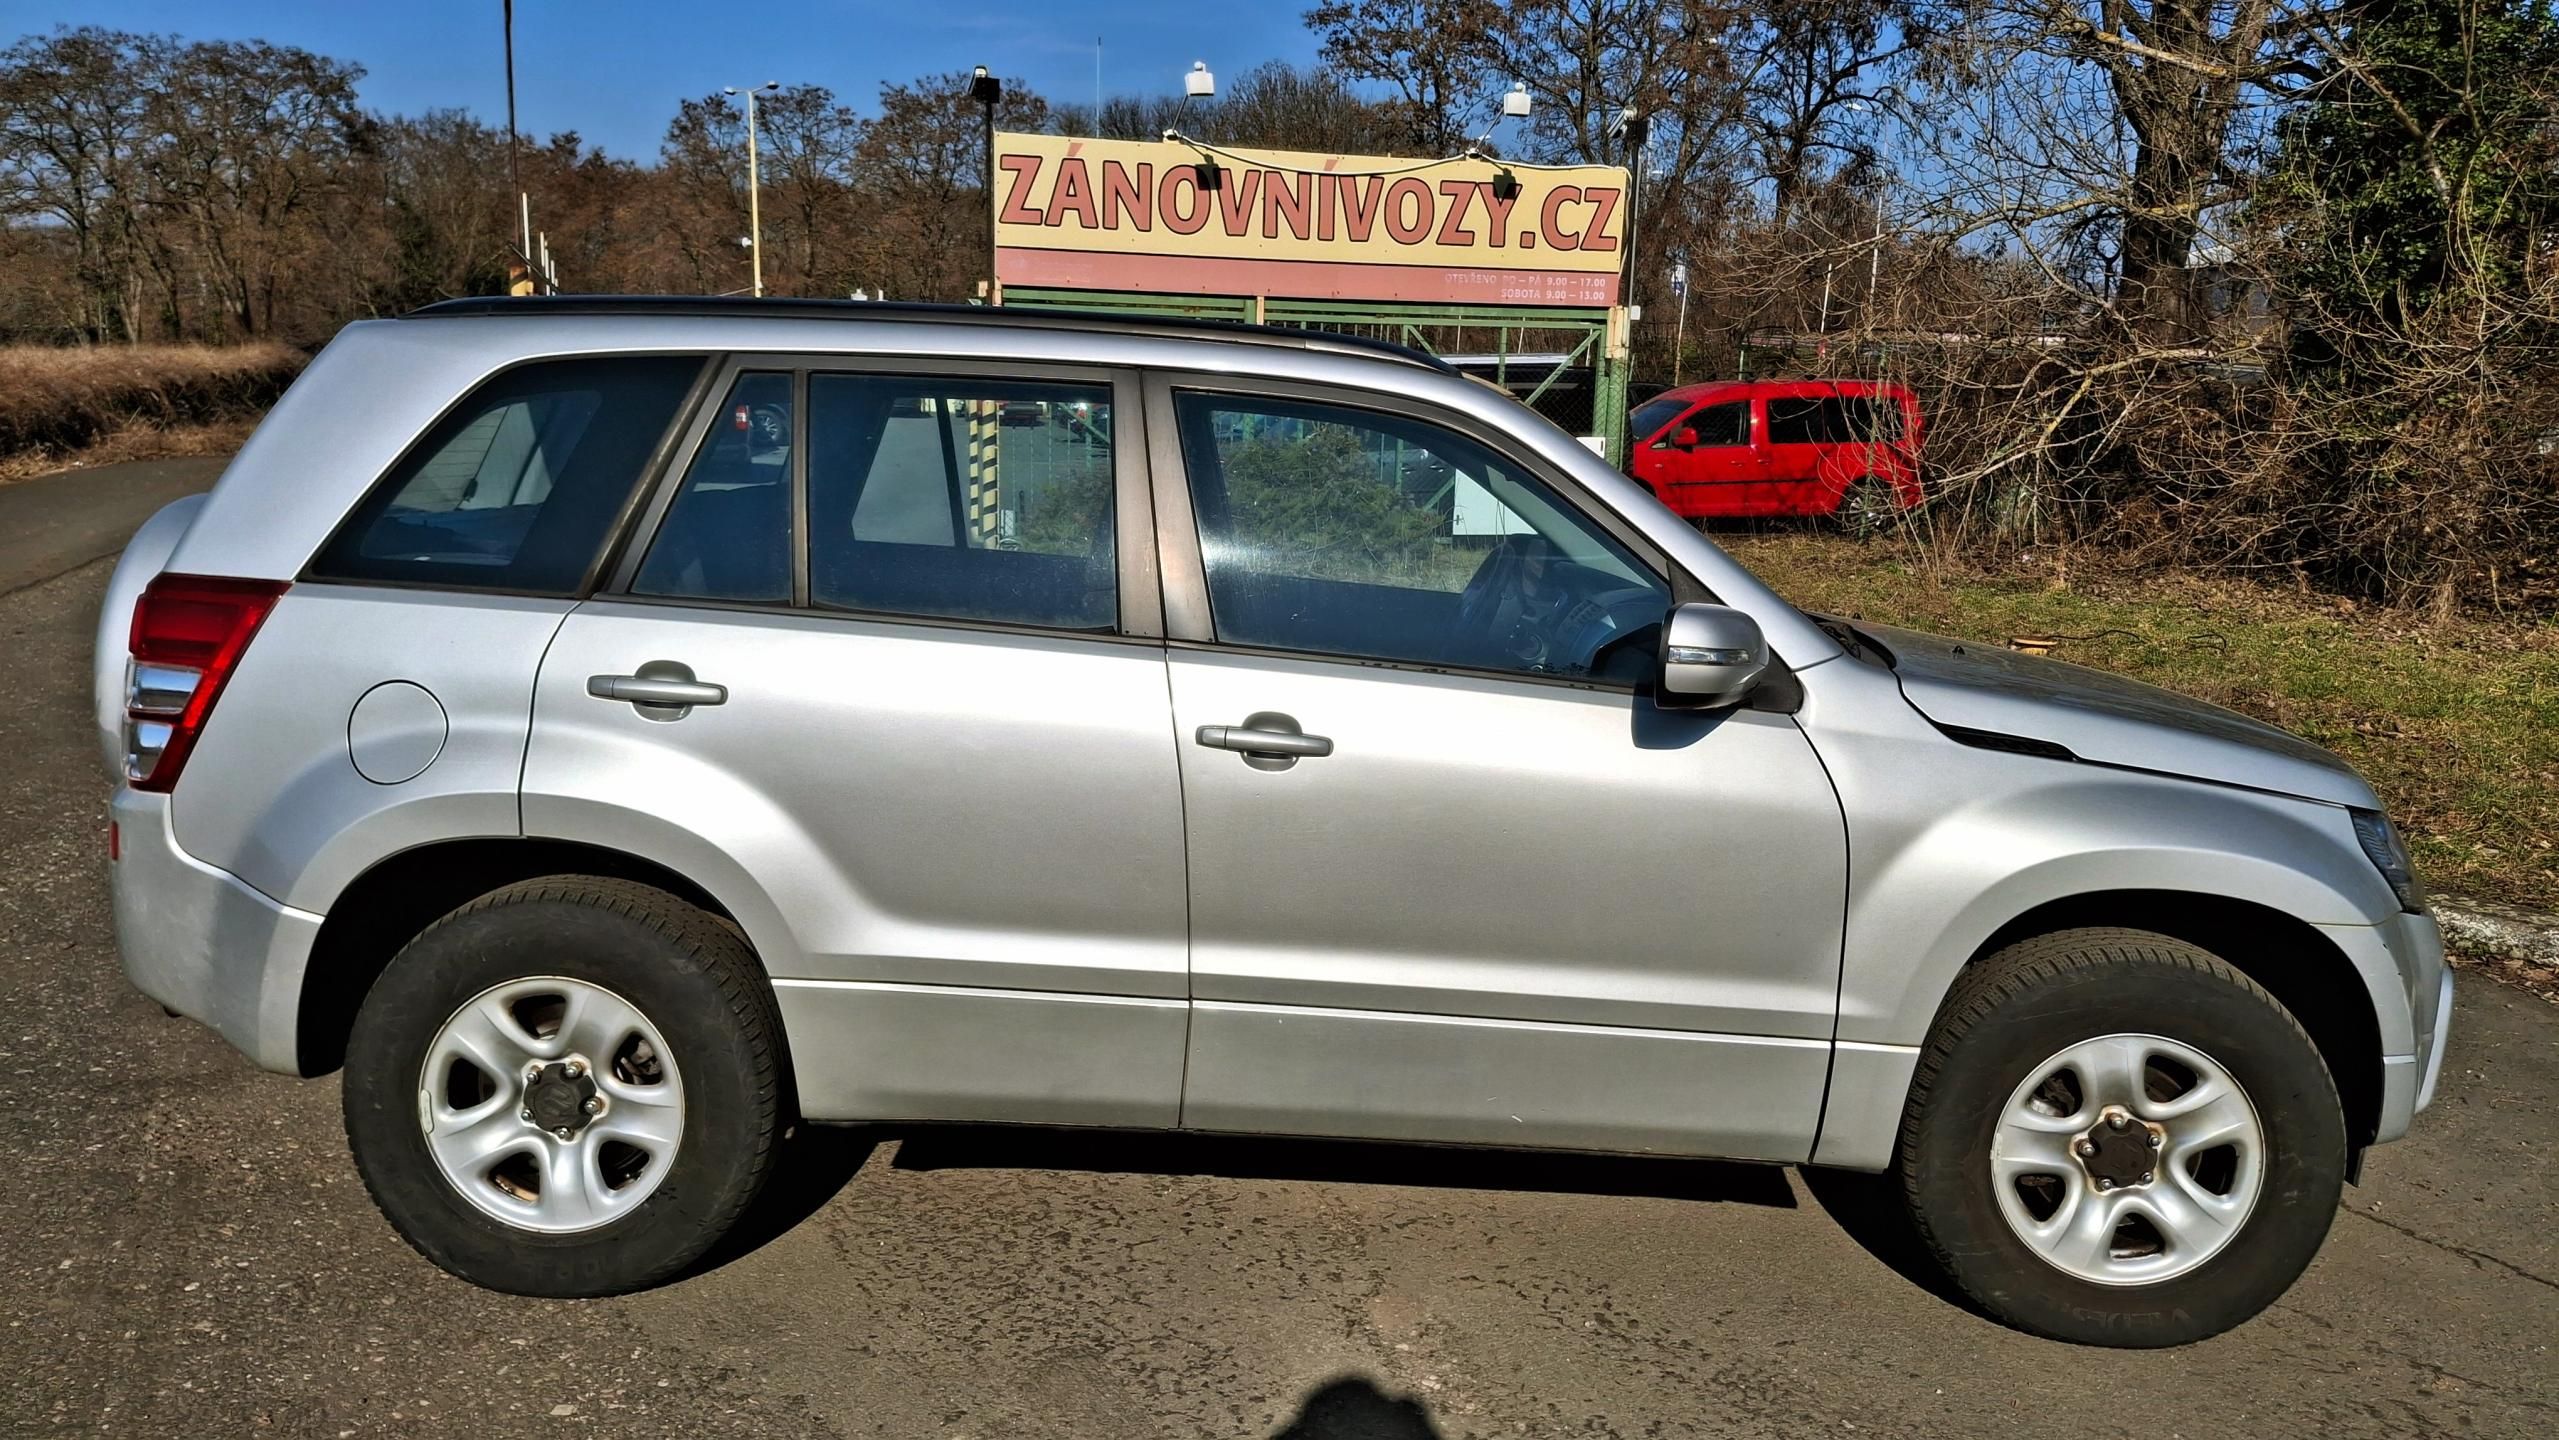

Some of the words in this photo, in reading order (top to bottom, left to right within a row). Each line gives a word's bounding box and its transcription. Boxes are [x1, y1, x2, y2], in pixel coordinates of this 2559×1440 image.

[999, 142, 1621, 251] ZÁNOVNÍVOZY.CZ
[1547, 276, 1568, 287] 9.00
[1580, 277, 1606, 288] 17.00
[1501, 287, 1541, 299] SOBOTA
[1546, 289, 1567, 300] 9.00
